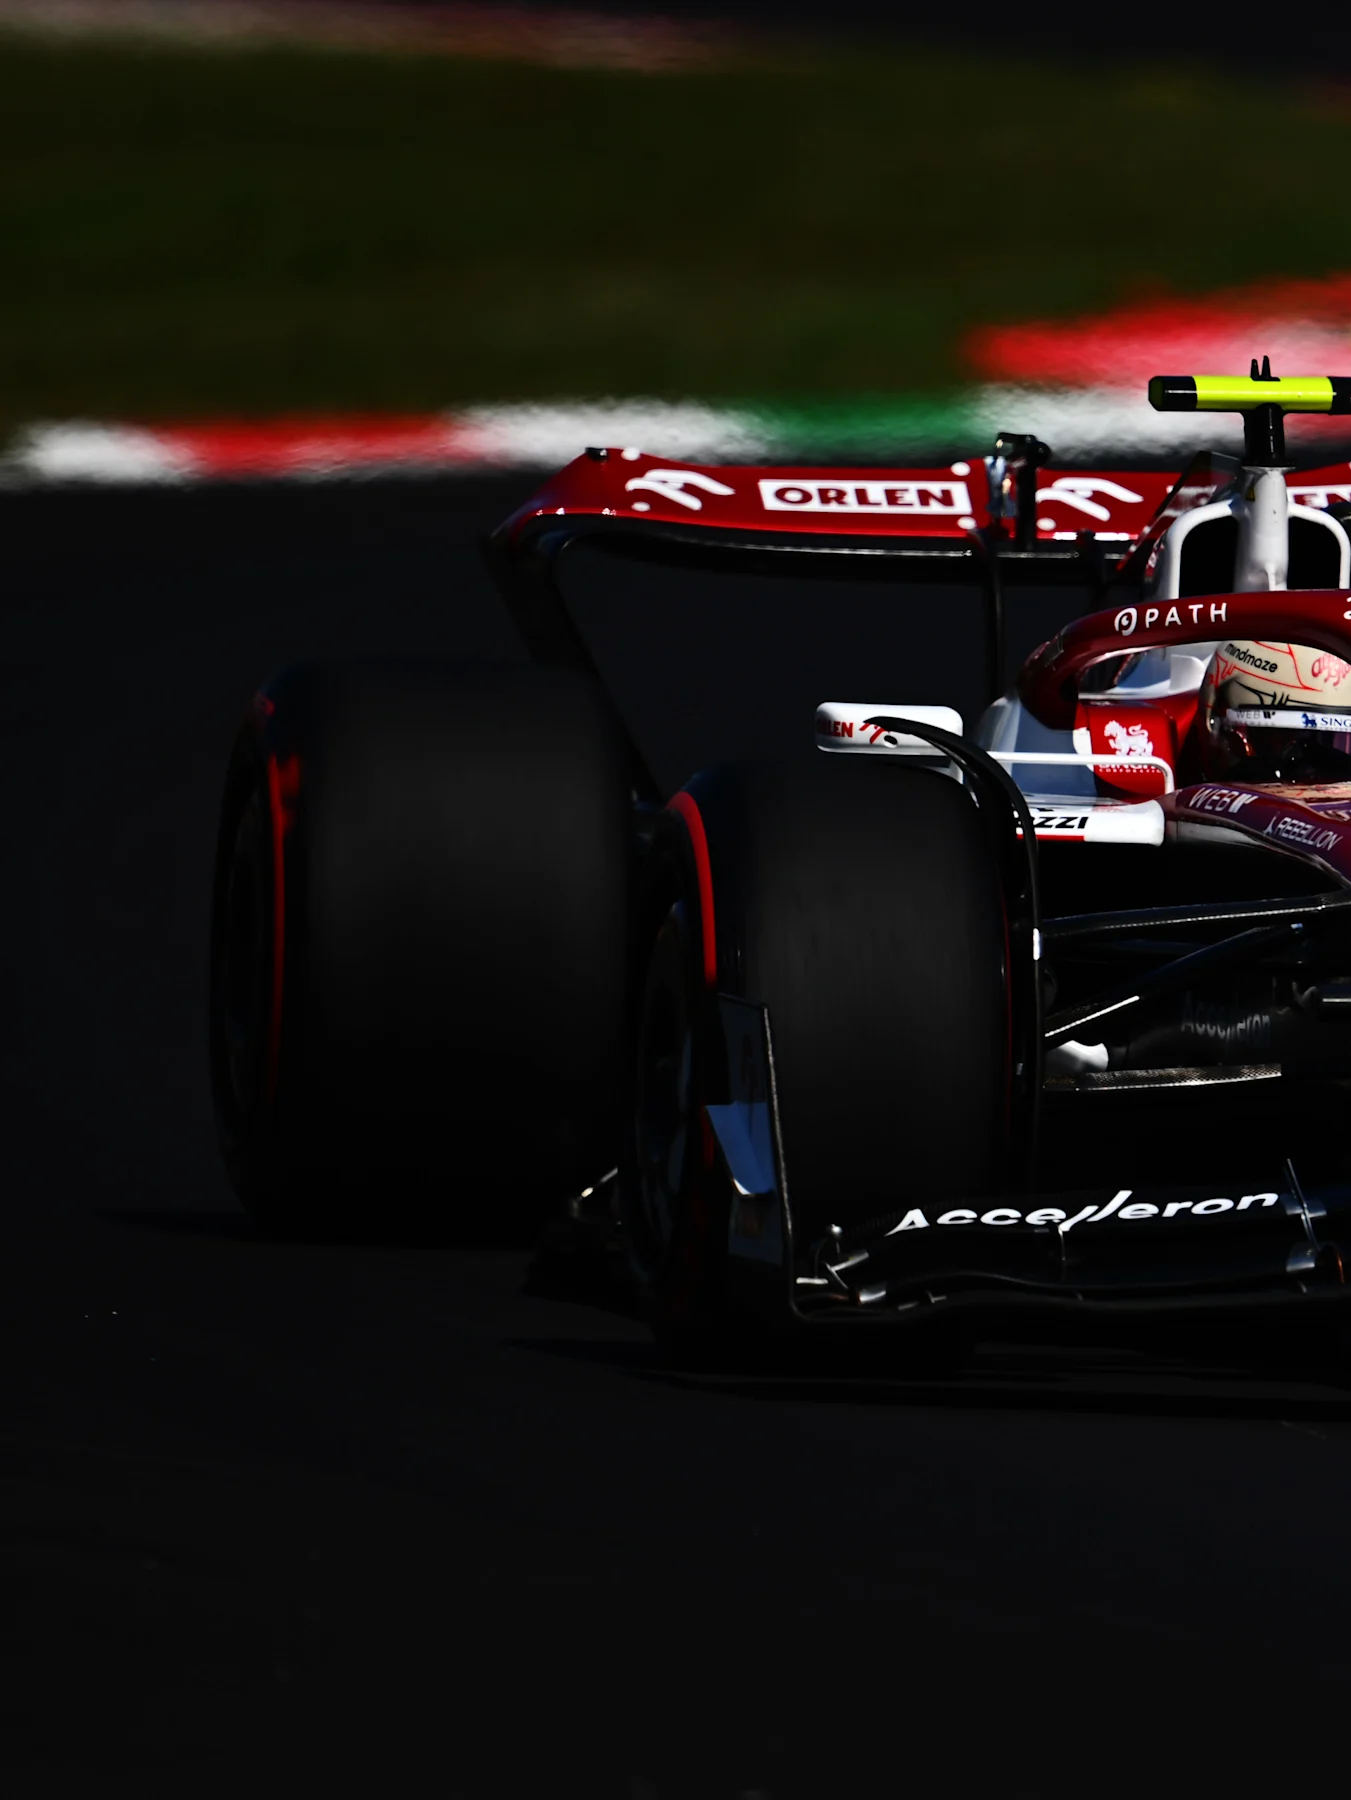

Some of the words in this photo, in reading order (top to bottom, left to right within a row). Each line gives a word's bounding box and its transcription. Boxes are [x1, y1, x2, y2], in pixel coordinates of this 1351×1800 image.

[775, 487, 956, 508] ORLEN
[1144, 602, 1228, 629] PATH
[1224, 643, 1278, 673] mindmaze
[1277, 816, 1345, 852] REBELLION
[883, 1189, 1281, 1238] Accelleron
